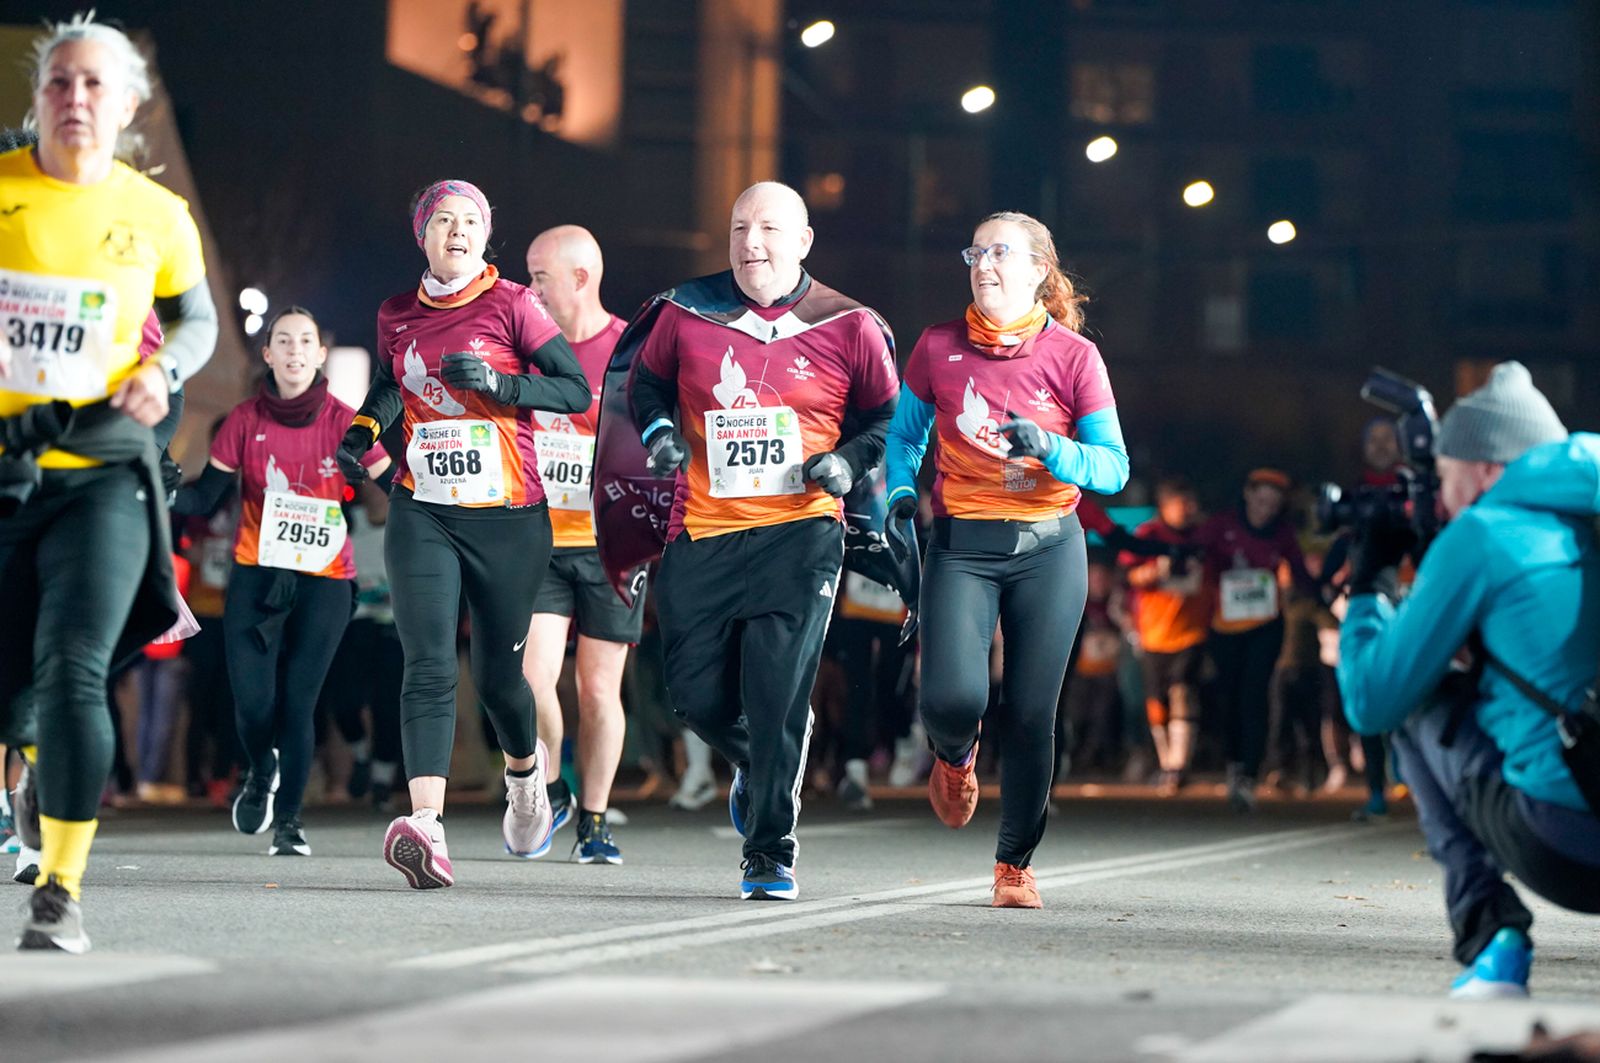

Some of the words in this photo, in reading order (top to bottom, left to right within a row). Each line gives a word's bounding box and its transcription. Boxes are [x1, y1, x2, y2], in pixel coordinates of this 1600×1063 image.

[8, 318, 85, 353] 3479
[422, 382, 444, 405] 43
[451, 428, 461, 438] DE
[717, 429, 735, 440] SAN
[736, 426, 768, 439] ANTÓN
[726, 417, 754, 428] NOCHE
[756, 417, 767, 427] DE
[976, 425, 1001, 449] 43
[424, 449, 482, 477] 1368
[726, 438, 785, 467] 2573
[604, 480, 627, 502] El
[276, 521, 330, 547] 2955
